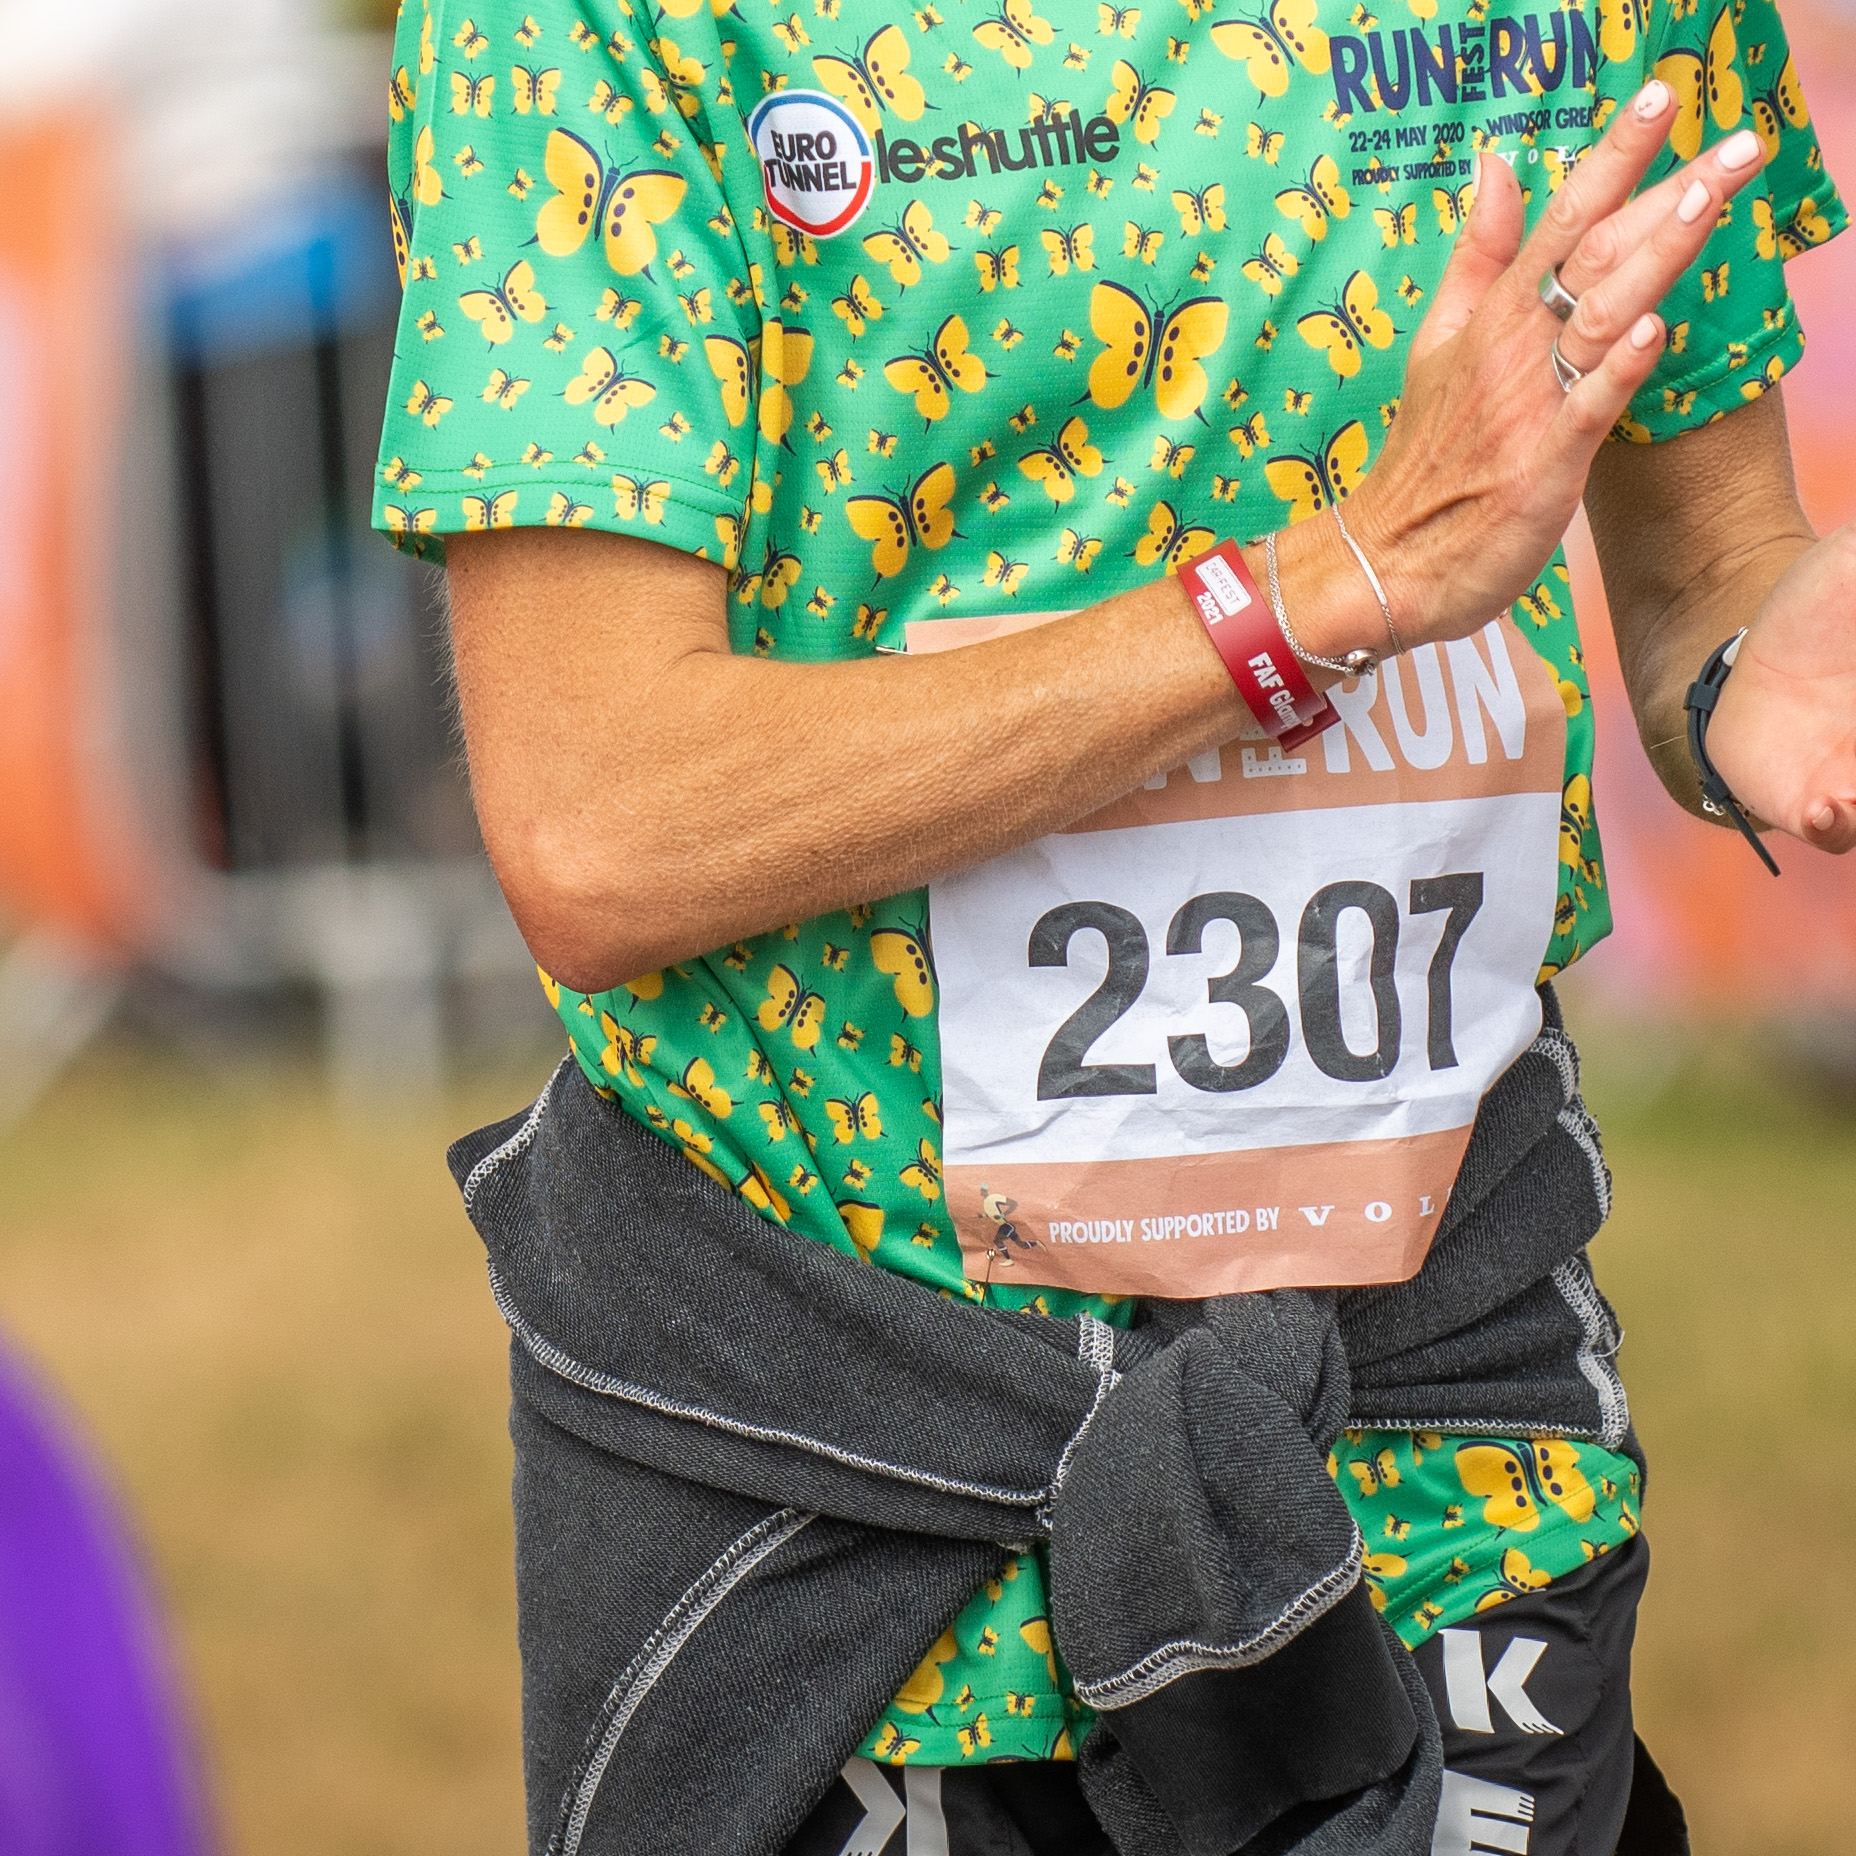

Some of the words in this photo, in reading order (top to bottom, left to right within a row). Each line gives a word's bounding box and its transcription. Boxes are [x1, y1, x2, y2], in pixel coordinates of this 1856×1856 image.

[1329, 22, 1458, 114] RUN
[1459, 21, 1486, 103] FEST
[1490, 8, 1597, 99] RUN
[770, 129, 837, 164] EURO
[1348, 129, 1392, 153] 22-24
[1395, 124, 1428, 149] MAY
[1433, 120, 1465, 145] 2020
[1486, 108, 1552, 137] WINDSOR
[1554, 106, 1596, 130] GREA
[764, 158, 857, 193] TUNNEL
[1352, 165, 1400, 186] PROUDLY
[1402, 159, 1456, 181] SUPPORTED
[1458, 158, 1472, 176] BY
[1196, 591, 1224, 626] 2021
[1247, 651, 1285, 689] FAF
[1325, 619, 1527, 776] RUN
[1026, 871, 1485, 1102] 2307
[1048, 1219, 1134, 1244] PROUDLY
[1140, 1209, 1247, 1241] SUPPORTED
[1256, 1206, 1280, 1231] BY
[1297, 1185, 1454, 1227] VOL
